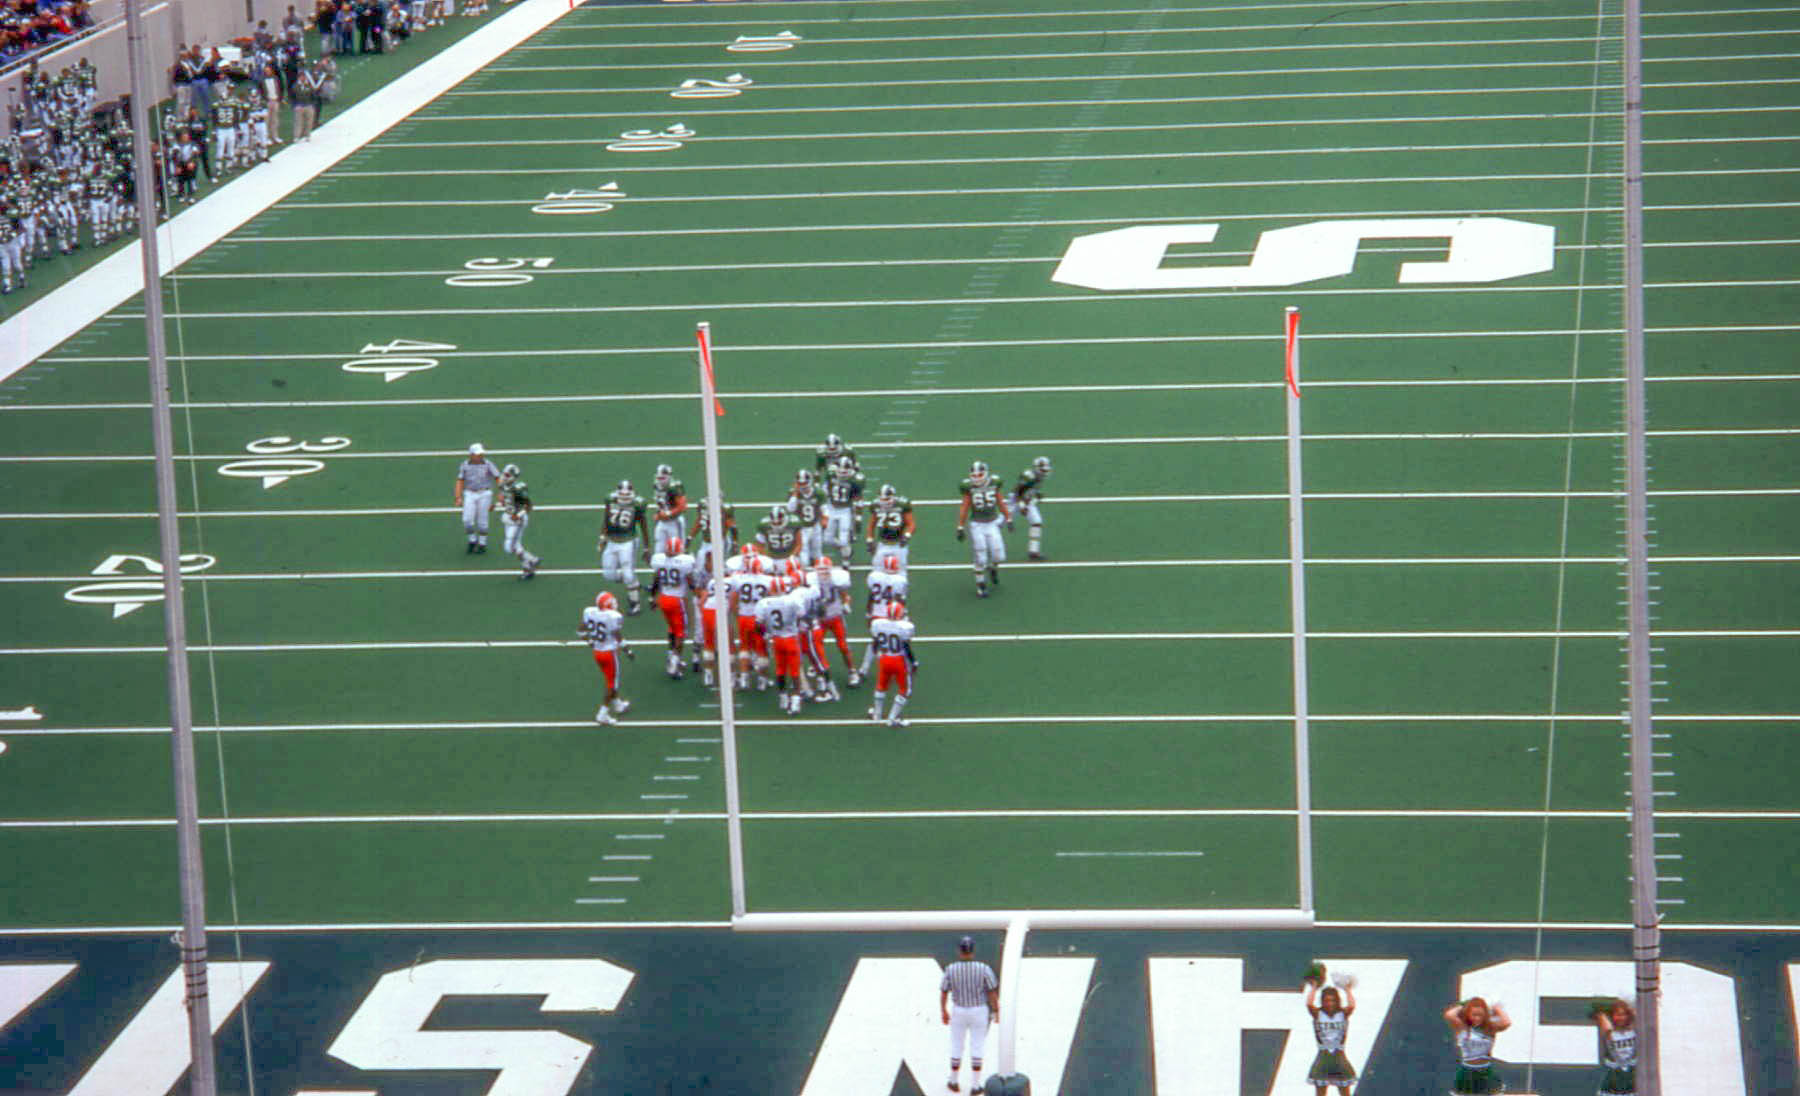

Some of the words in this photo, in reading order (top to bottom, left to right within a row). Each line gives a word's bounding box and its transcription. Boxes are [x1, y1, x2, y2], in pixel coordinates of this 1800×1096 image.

[1051, 217, 1556, 291] S
[444, 256, 556, 287] 50
[341, 338, 458, 374] 40
[217, 436, 352, 478] 30
[609, 507, 633, 527] 76
[876, 511, 903, 528] 73
[768, 532, 795, 549] 52
[739, 581, 768, 604] 93
[769, 608, 785, 631] 3
[876, 631, 901, 654] 20
